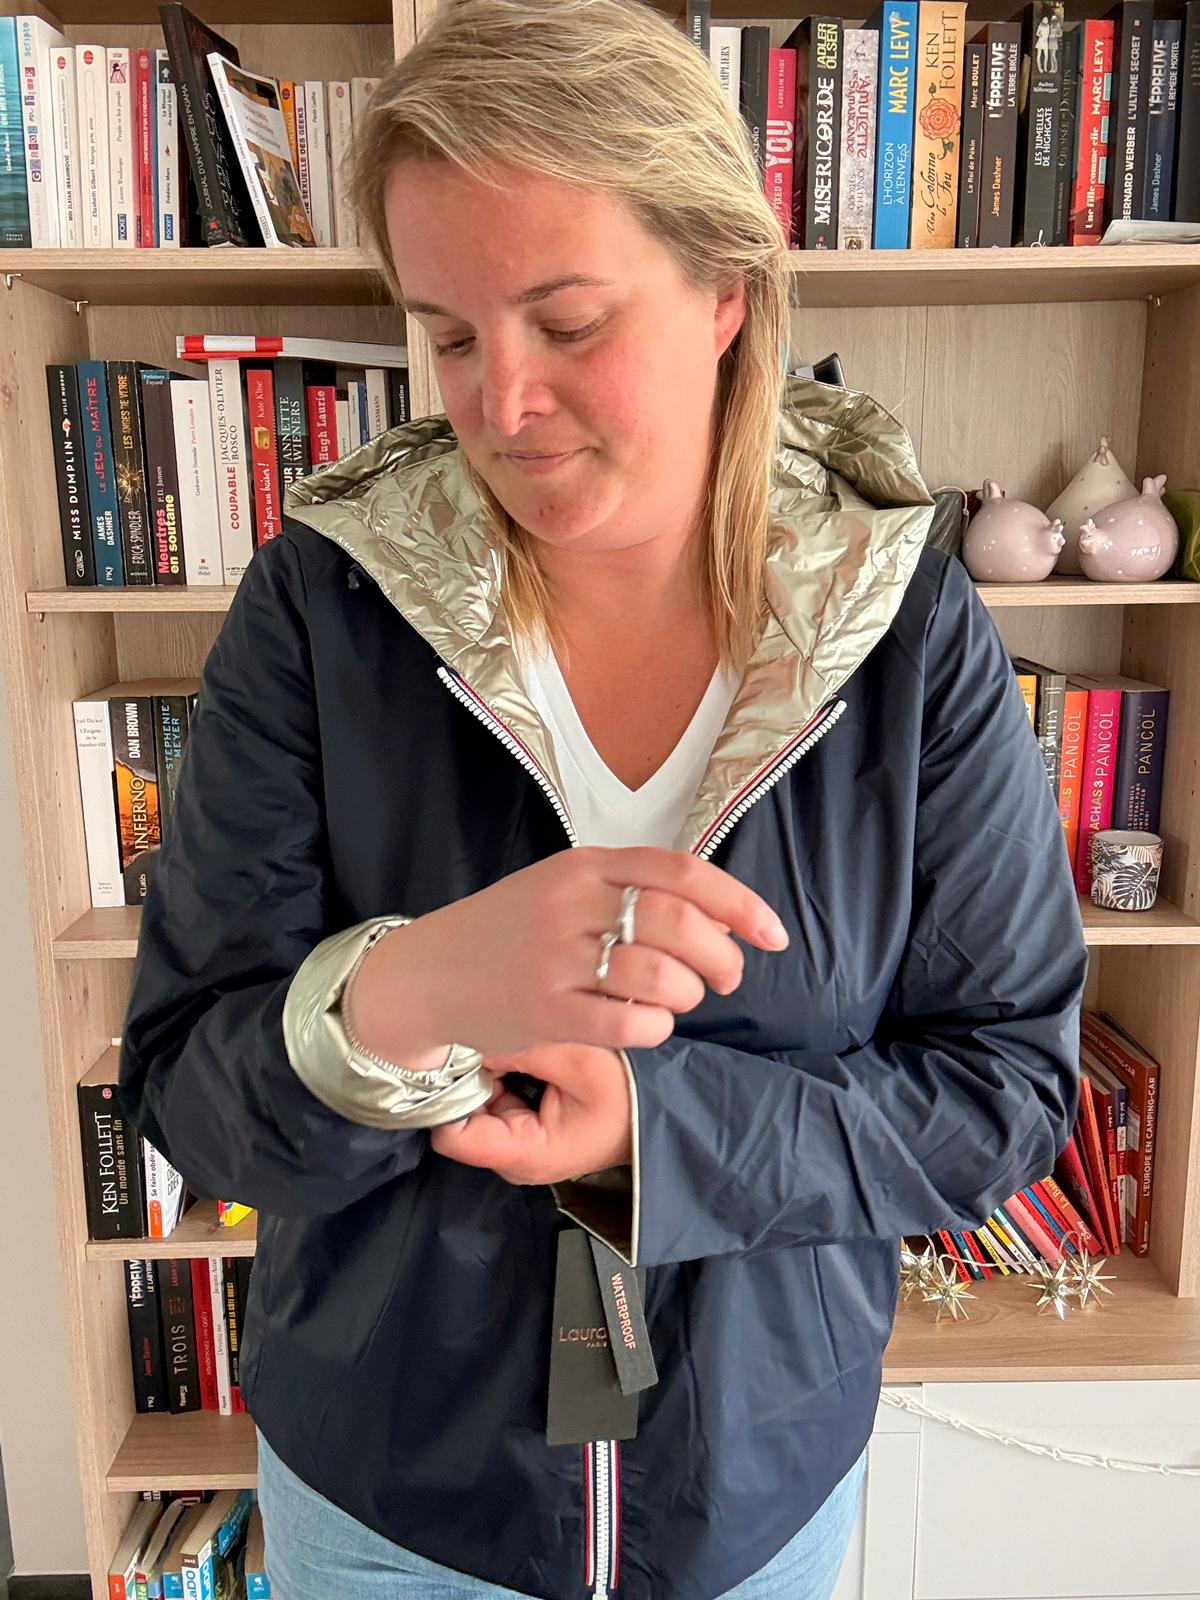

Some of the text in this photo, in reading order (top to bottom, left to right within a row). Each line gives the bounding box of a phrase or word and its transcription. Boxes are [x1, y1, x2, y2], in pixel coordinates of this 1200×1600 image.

[826, 24, 838, 69] OLSEN
[888, 17, 911, 114] MARC LEVY
[926, 32, 939, 68] KEN
[940, 10, 958, 89] FOLLETT
[972, 54, 980, 86] BOULET
[1171, 41, 1180, 70] MORTEL
[181, 84, 192, 113] PYJAMA
[1008, 72, 1016, 96] TERRE
[1008, 96, 1016, 107] LA
[1092, 40, 1105, 115] MARC LEVY
[1128, 35, 1141, 120] L'ULTIME SECRET
[186, 114, 194, 124] EN
[1168, 101, 1175, 111] LE
[190, 126, 201, 156] VAMPIRE
[765, 119, 793, 168] YOU
[814, 77, 834, 225] MISERICORDE
[1034, 107, 1044, 166] LES JUMELLES
[1042, 106, 1053, 167] DE HIGHGATE
[300, 156, 308, 200] SEXUELLE
[775, 172, 782, 186] ON
[883, 142, 894, 204] L'HORIZON
[896, 144, 908, 194] L'ENVERS
[968, 161, 974, 170] de
[968, 184, 974, 194] Le
[991, 156, 1002, 217] James Dashner
[1089, 147, 1098, 185] comme
[1122, 126, 1136, 221] BERNARD WERBER
[1150, 152, 1162, 213] James Dashner
[200, 175, 213, 209] JOURNAL
[215, 368, 230, 462] JACQUES-OLIVIER
[280, 396, 292, 460] ANNETTE
[290, 400, 303, 462] WIENERS
[316, 390, 330, 462] Hugh Laurie
[122, 435, 134, 450] LES
[230, 425, 240, 461] BOSCO
[64, 441, 79, 504] DUMPLIN
[156, 466, 164, 487] James
[227, 466, 240, 530] COUPABLE
[70, 508, 82, 540] MISS
[96, 516, 106, 541] JAMES
[104, 510, 115, 546] DASHNER
[128, 510, 143, 544] SPINDLER
[156, 508, 170, 574] Meurtres
[165, 494, 180, 574] en soutane
[130, 544, 145, 564] ERICA
[124, 702, 141, 759] DAN BROWN
[162, 704, 174, 770] STEPHENIE
[172, 718, 182, 758] MEYER
[1064, 710, 1082, 778] PANCOL
[1096, 708, 1114, 776] PANCOL
[1138, 709, 1156, 774] PANCOL
[130, 776, 148, 850] INFERNO
[1144, 1077, 1156, 1196] L'EUROPE EN CAMPING-CAR
[94, 1112, 119, 1214] KEN FOLLETT
[113, 1120, 128, 1205] Un monde sans fin
[151, 1187, 158, 1196] Se
[559, 1326, 608, 1342] Laura
[611, 1272, 636, 1349] WATERPROOF
[171, 1324, 188, 1374] TROIS
